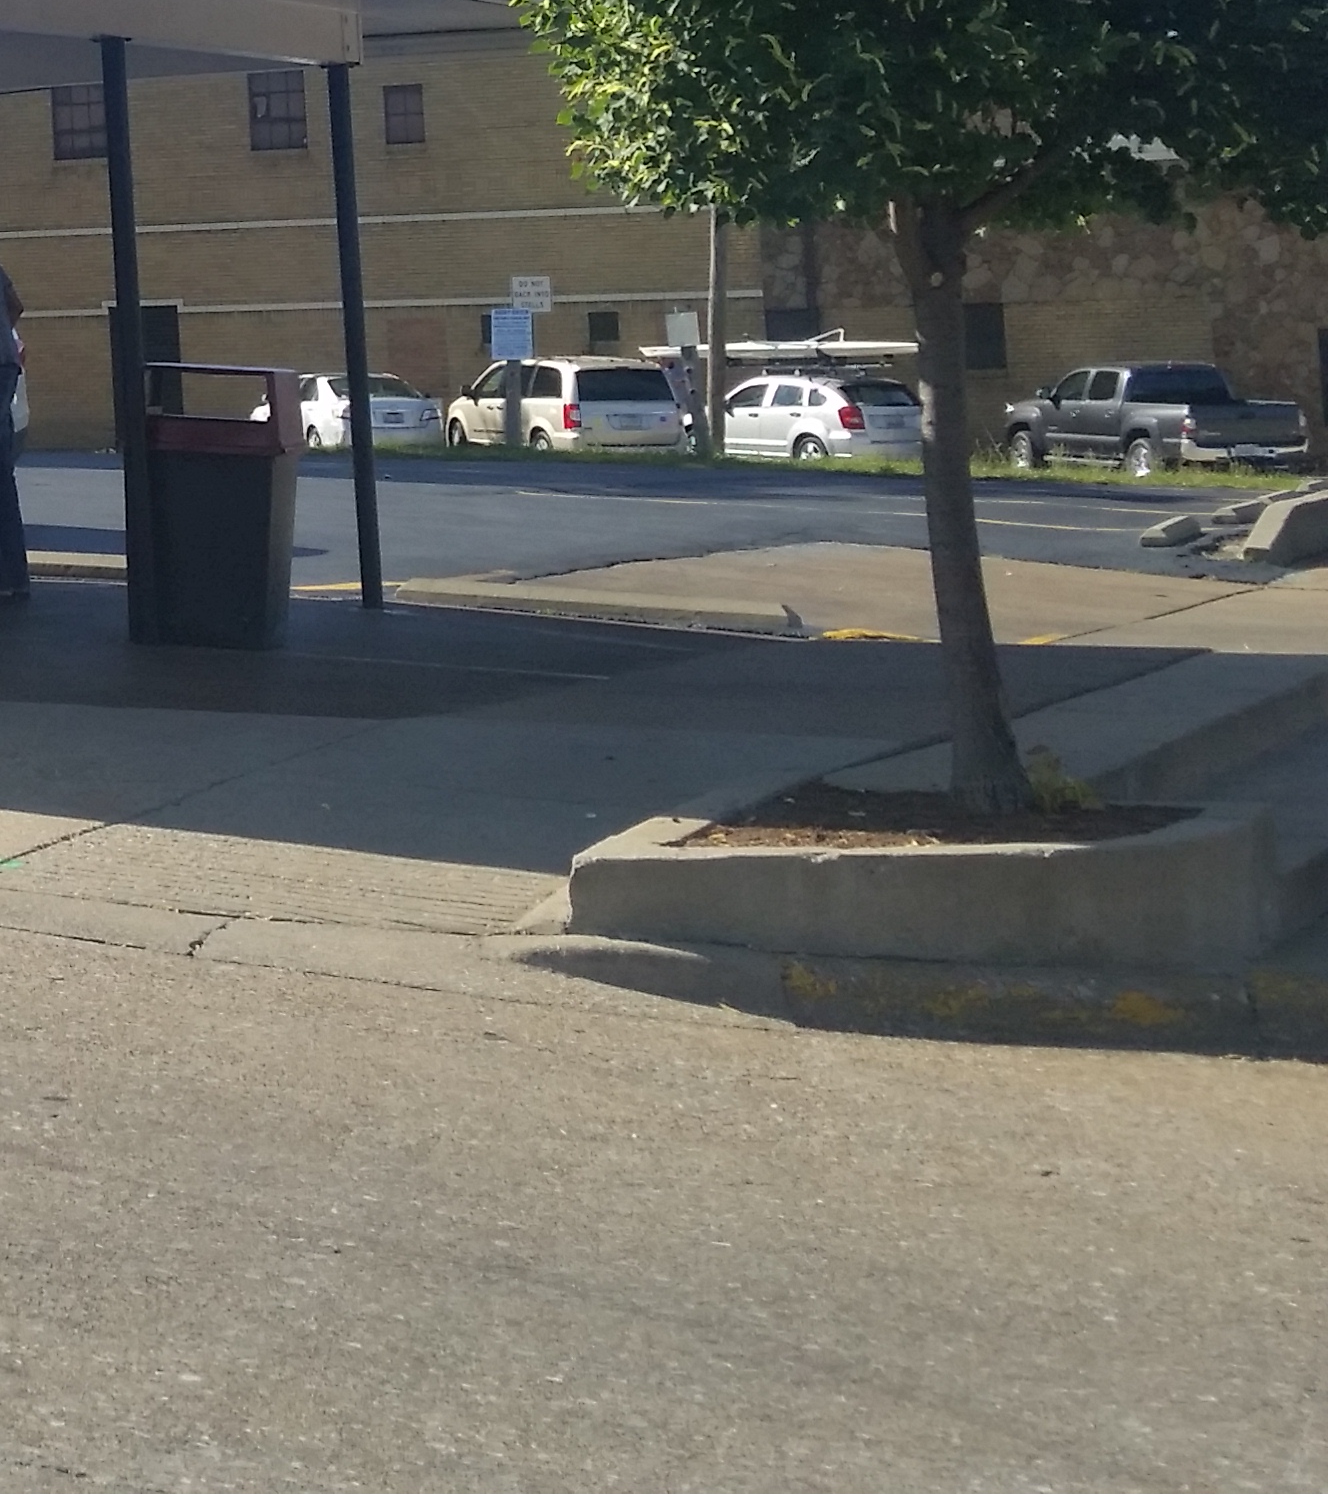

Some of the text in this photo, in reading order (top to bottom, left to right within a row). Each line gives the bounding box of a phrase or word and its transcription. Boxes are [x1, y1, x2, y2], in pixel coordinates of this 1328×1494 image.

[518, 280, 544, 288] DO NOT
[534, 290, 549, 298] INTO
